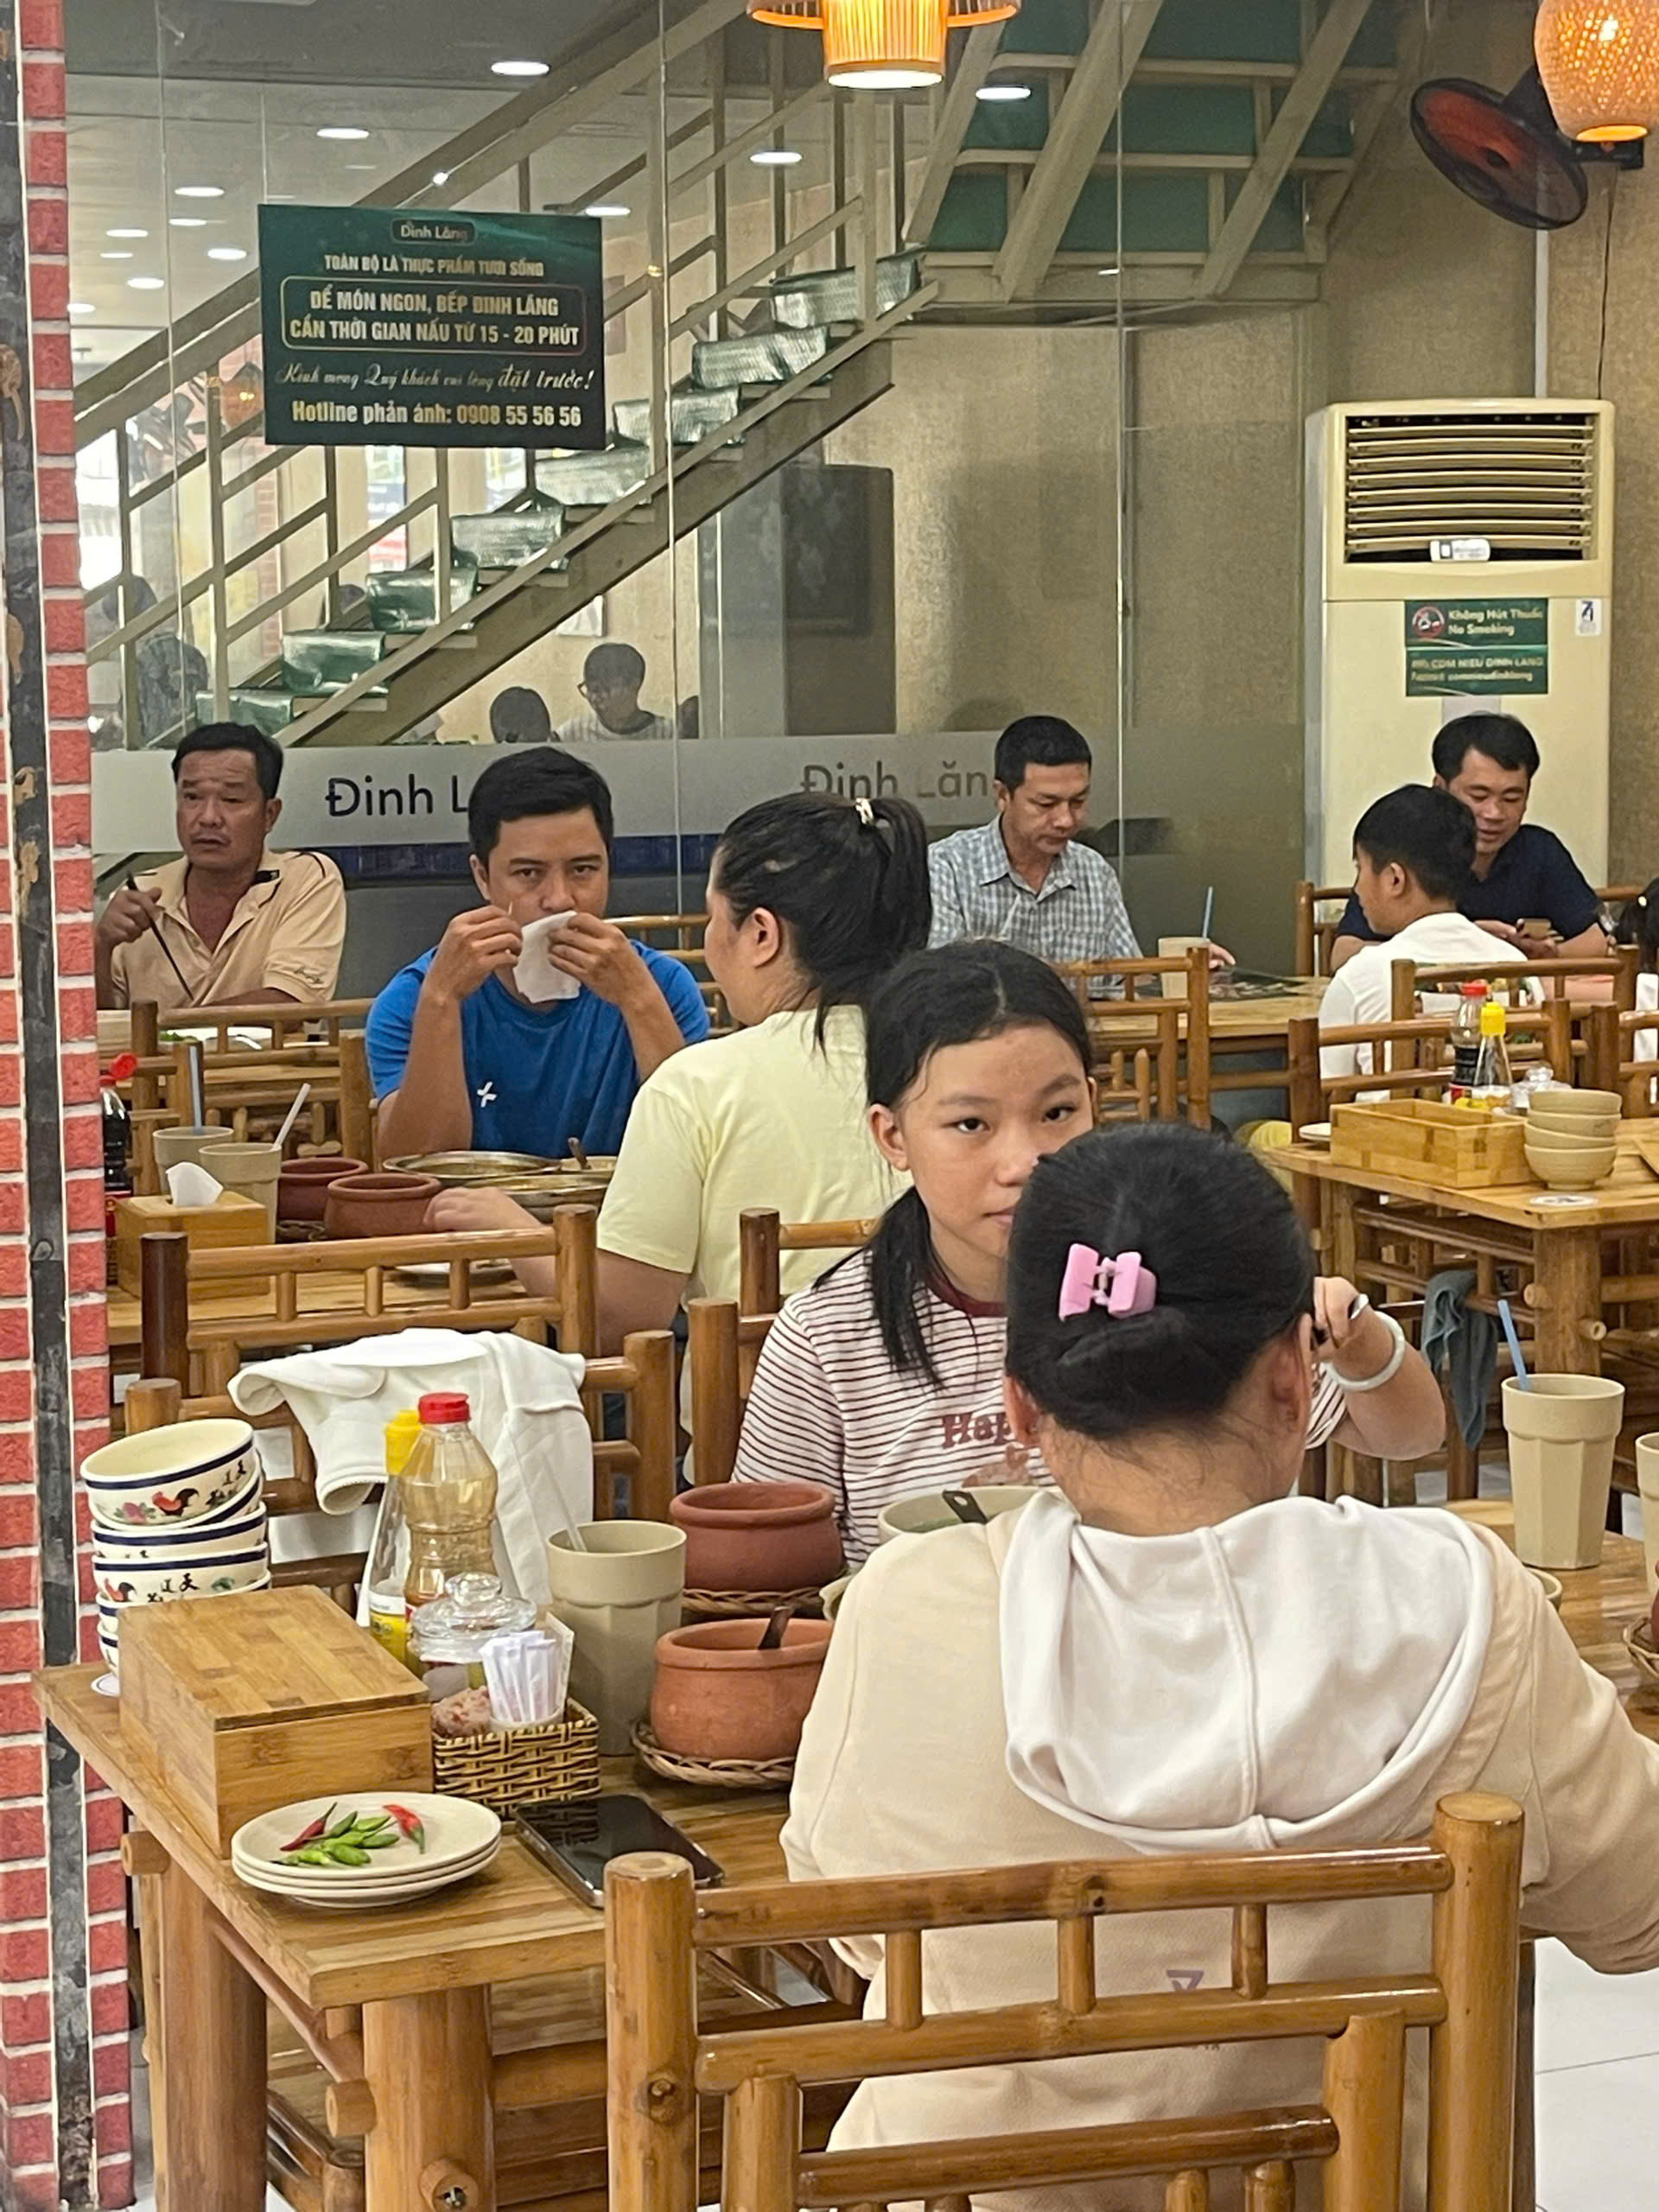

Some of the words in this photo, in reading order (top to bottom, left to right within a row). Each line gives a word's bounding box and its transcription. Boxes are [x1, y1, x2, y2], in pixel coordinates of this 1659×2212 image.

[324, 252, 359, 270] TOÀN
[361, 253, 379, 275] BỘ
[382, 254, 399, 272] LÀ
[337, 287, 377, 311] MÓN
[380, 292, 431, 314] NGON,
[436, 289, 467, 314] BẾP
[372, 321, 412, 341] GIAN
[480, 325, 499, 344] 15
[514, 326, 534, 345] 20
[538, 322, 580, 346] PHÚT
[497, 363, 531, 392] đặt
[292, 400, 358, 423] Hotline
[362, 399, 409, 426] phản
[413, 403, 453, 424] ánh:
[456, 404, 501, 425] 0908
[505, 405, 528, 426] 55
[531, 406, 555, 427] 56
[558, 406, 582, 427] 56
[1448, 609, 1484, 622] Không
[1447, 624, 1465, 634] No
[1466, 623, 1516, 637] Smoking
[916, 760, 989, 798] ăn
[325, 773, 434, 817] Đinh
[942, 1412, 1013, 1449] Hap
